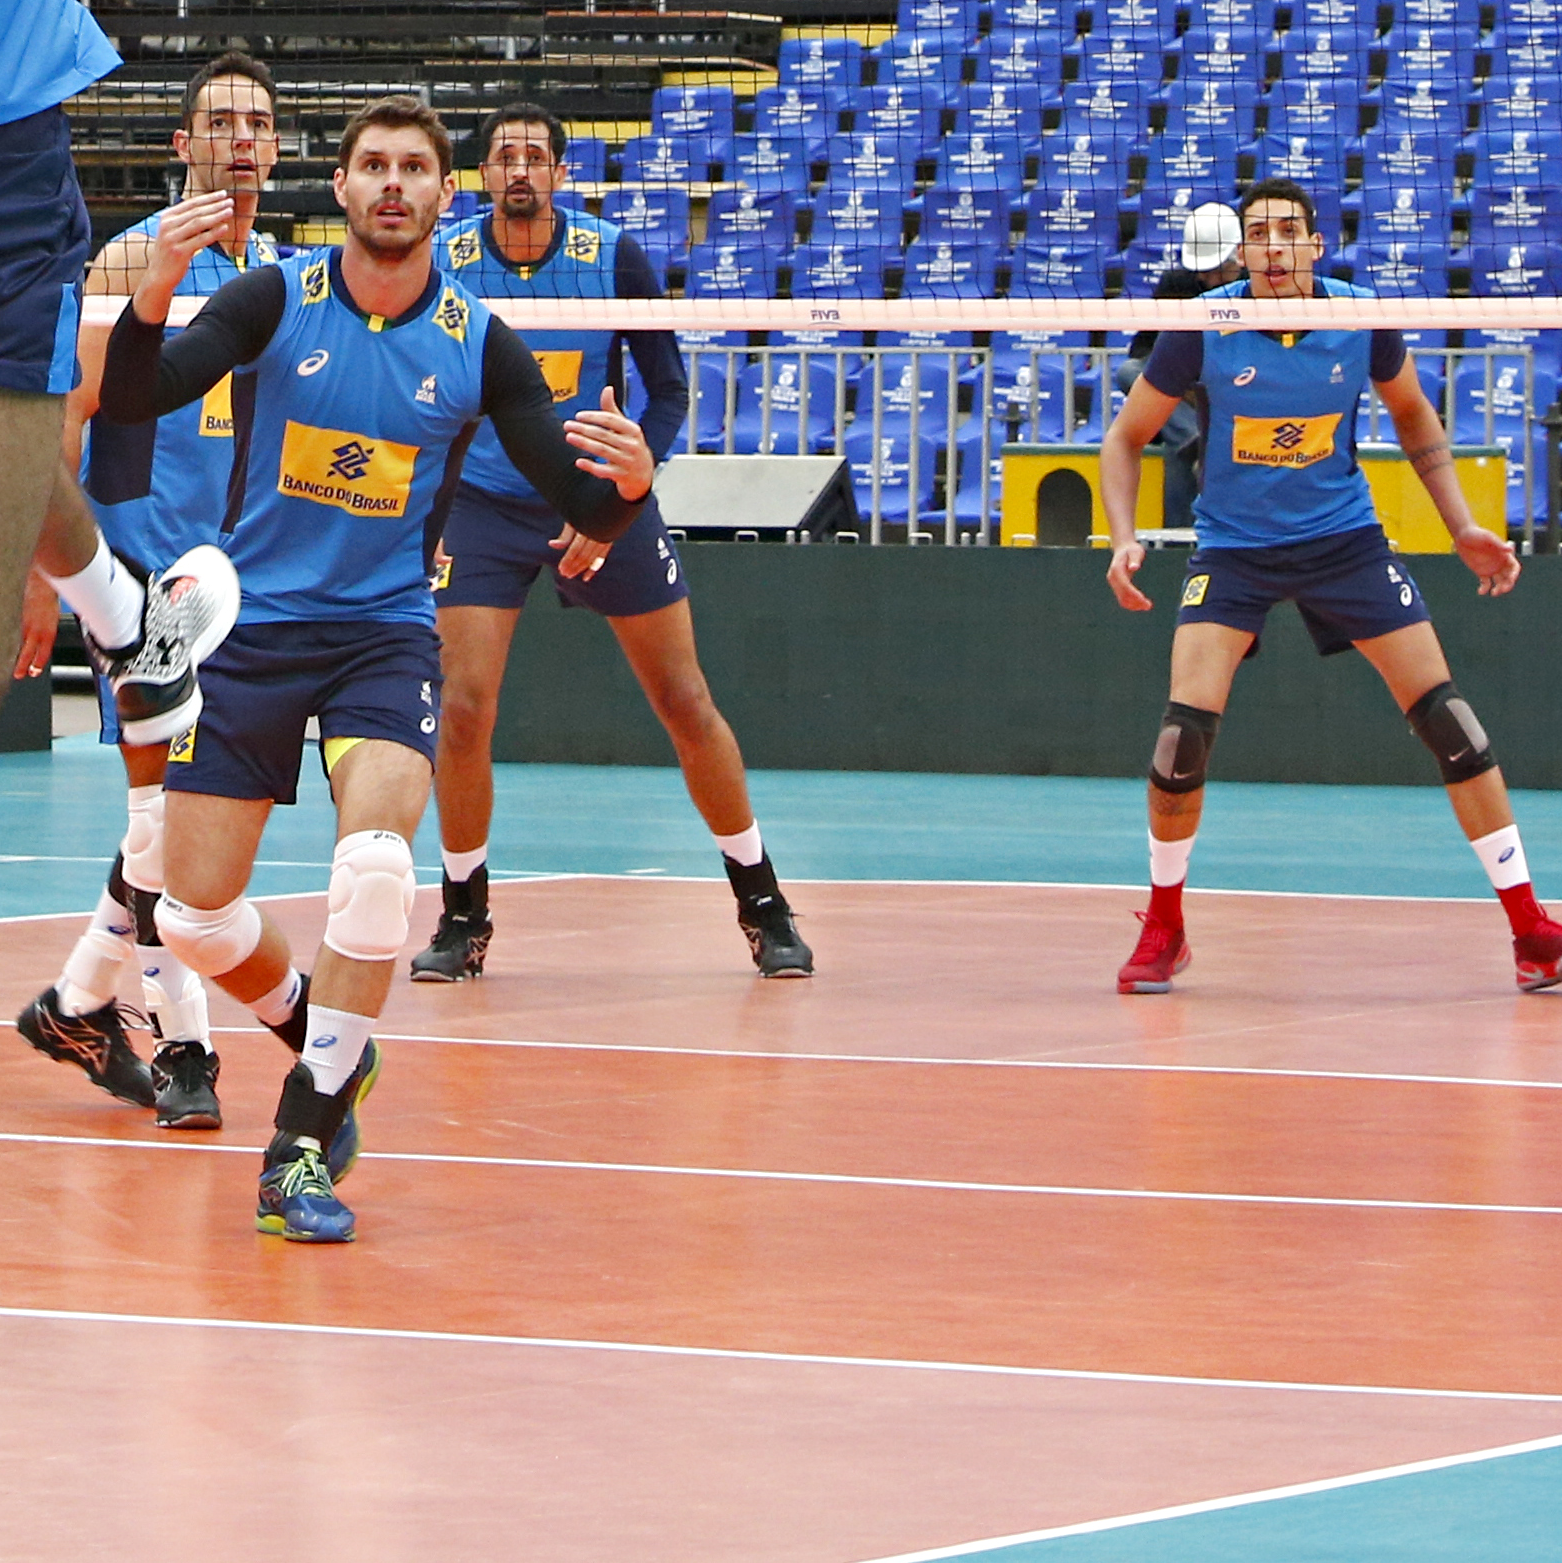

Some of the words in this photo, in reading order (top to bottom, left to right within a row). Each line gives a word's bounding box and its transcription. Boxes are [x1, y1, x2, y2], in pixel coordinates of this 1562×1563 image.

[810, 309, 841, 321] FIVB
[1210, 308, 1241, 320] FIVB
[1238, 450, 1278, 462] BANCO
[283, 474, 334, 498] BANCO
[351, 491, 399, 512] BRASIL
